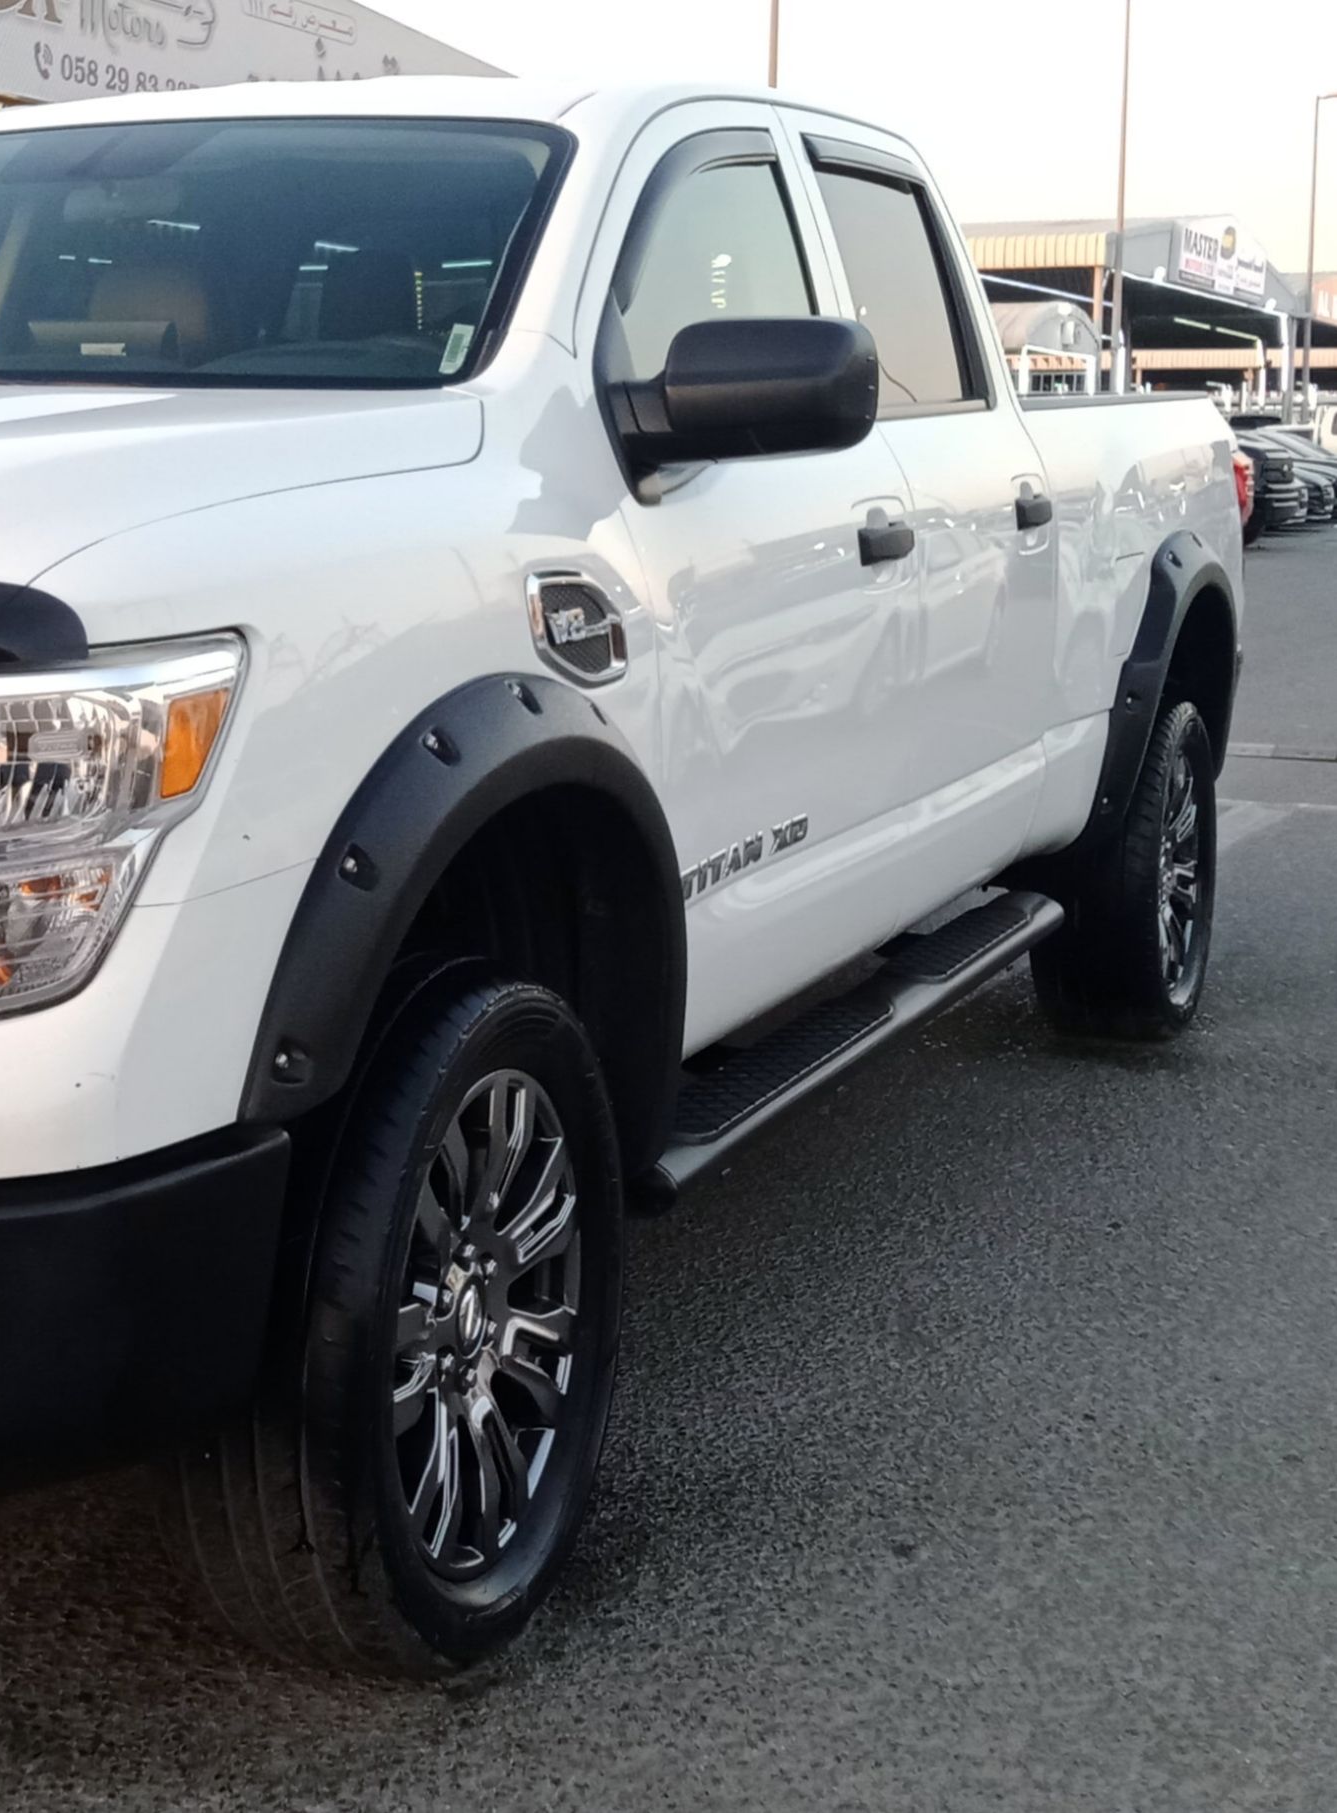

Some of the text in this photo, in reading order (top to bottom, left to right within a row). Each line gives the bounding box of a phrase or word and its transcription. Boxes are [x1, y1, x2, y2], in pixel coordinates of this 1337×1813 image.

[61, 53, 98, 87] 058
[105, 64, 129, 92] 29
[1183, 227, 1219, 263] MASTER
[680, 813, 809, 901] TITAN XD
